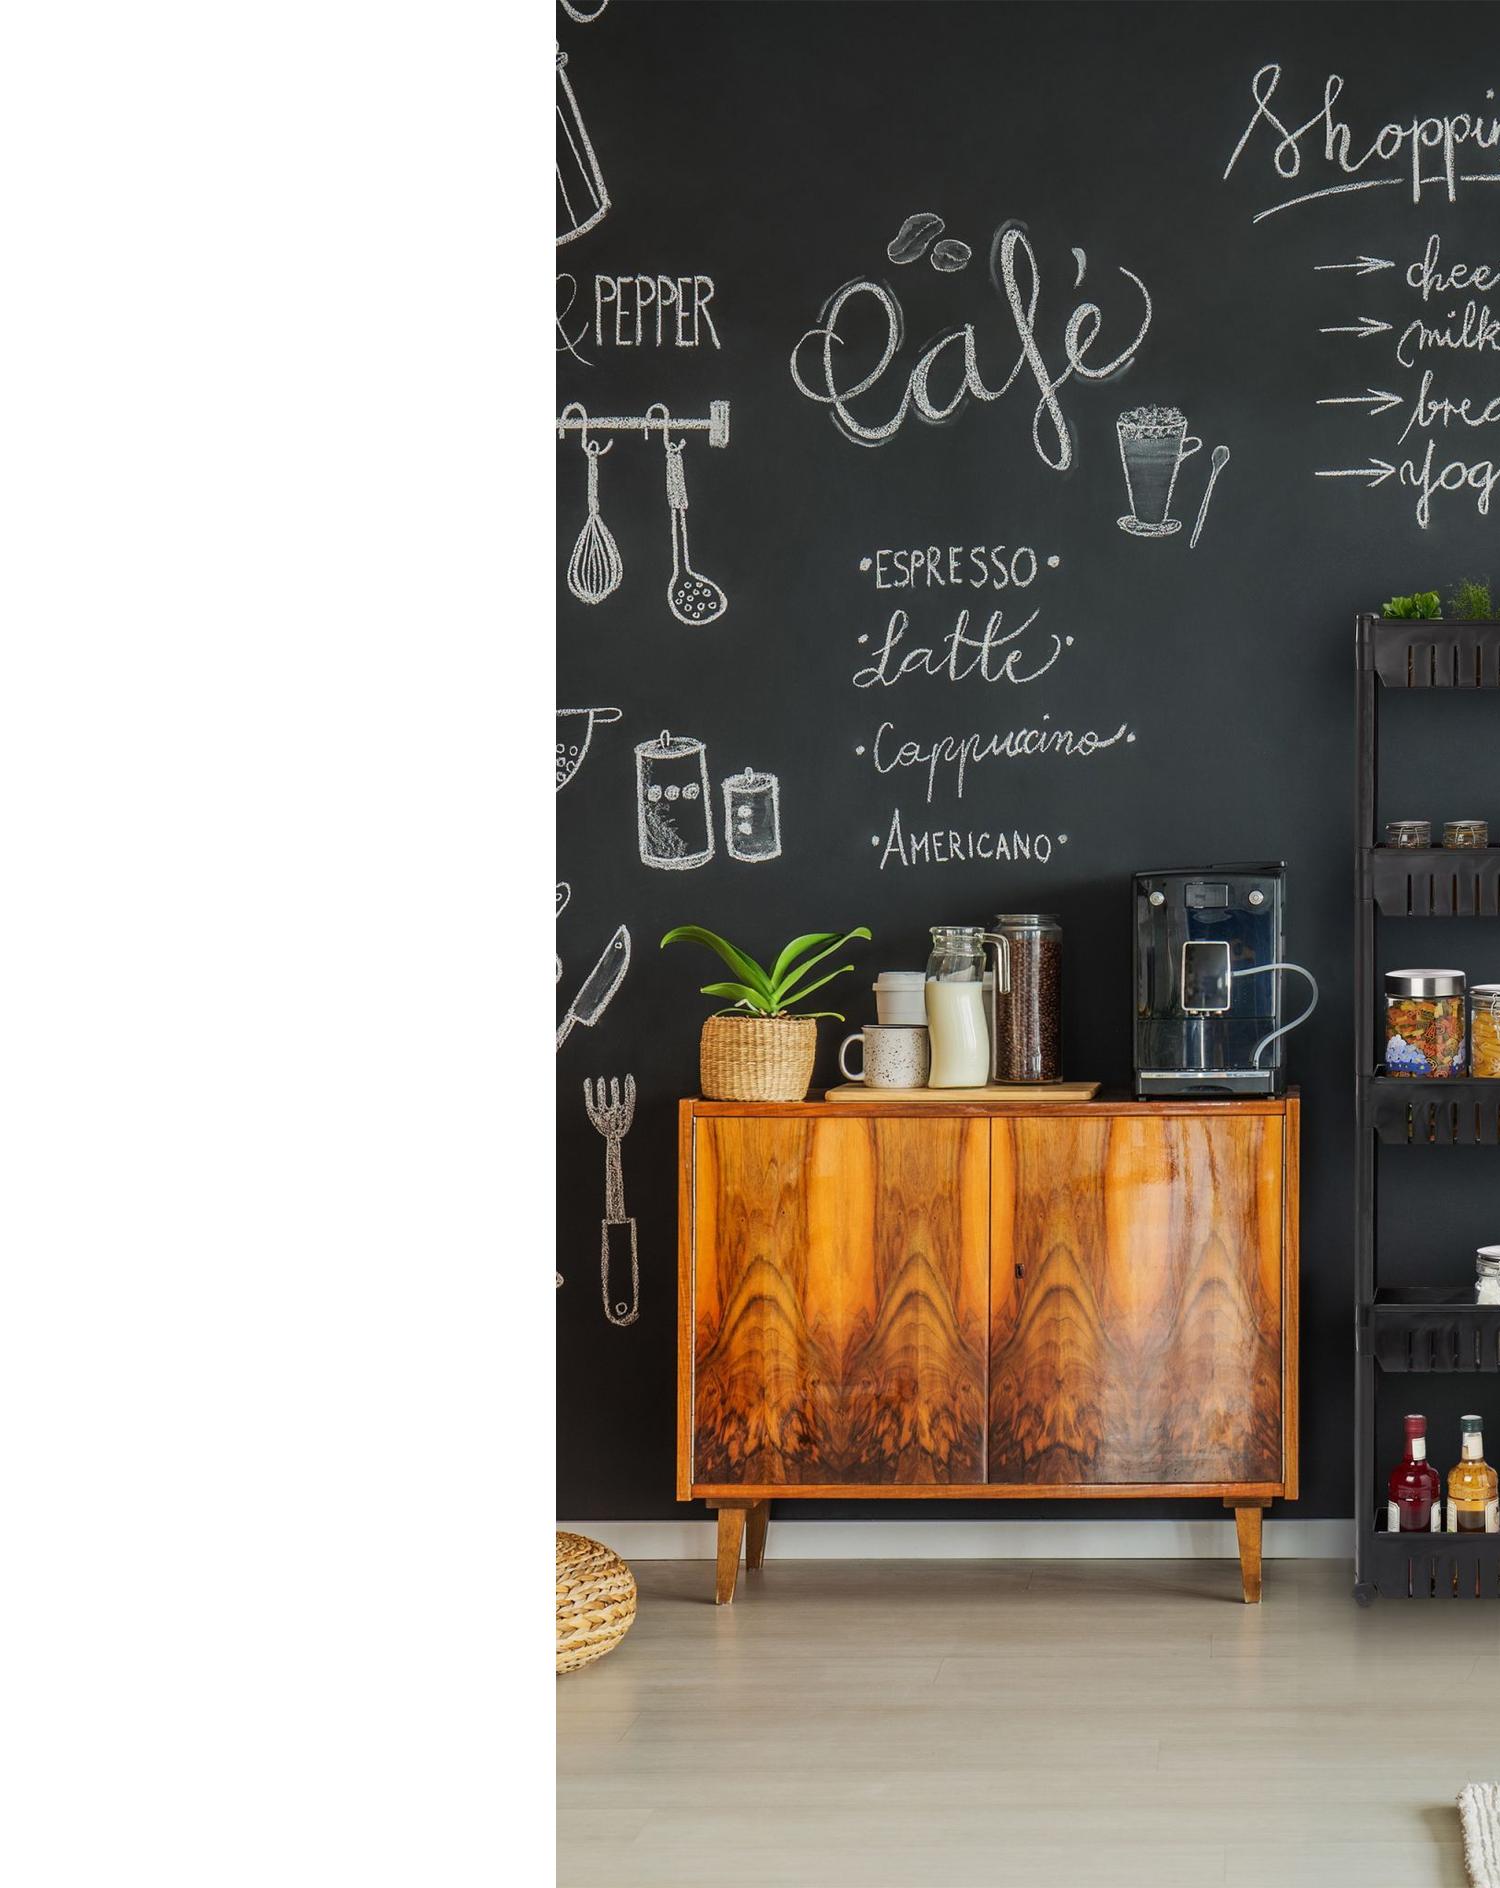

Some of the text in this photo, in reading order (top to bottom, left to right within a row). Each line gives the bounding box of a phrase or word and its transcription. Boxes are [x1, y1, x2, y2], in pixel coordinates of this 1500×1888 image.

[595, 274, 721, 350] PEPPER
[875, 545, 1038, 590] ESPRESSO
[852, 608, 1061, 688] Latte
